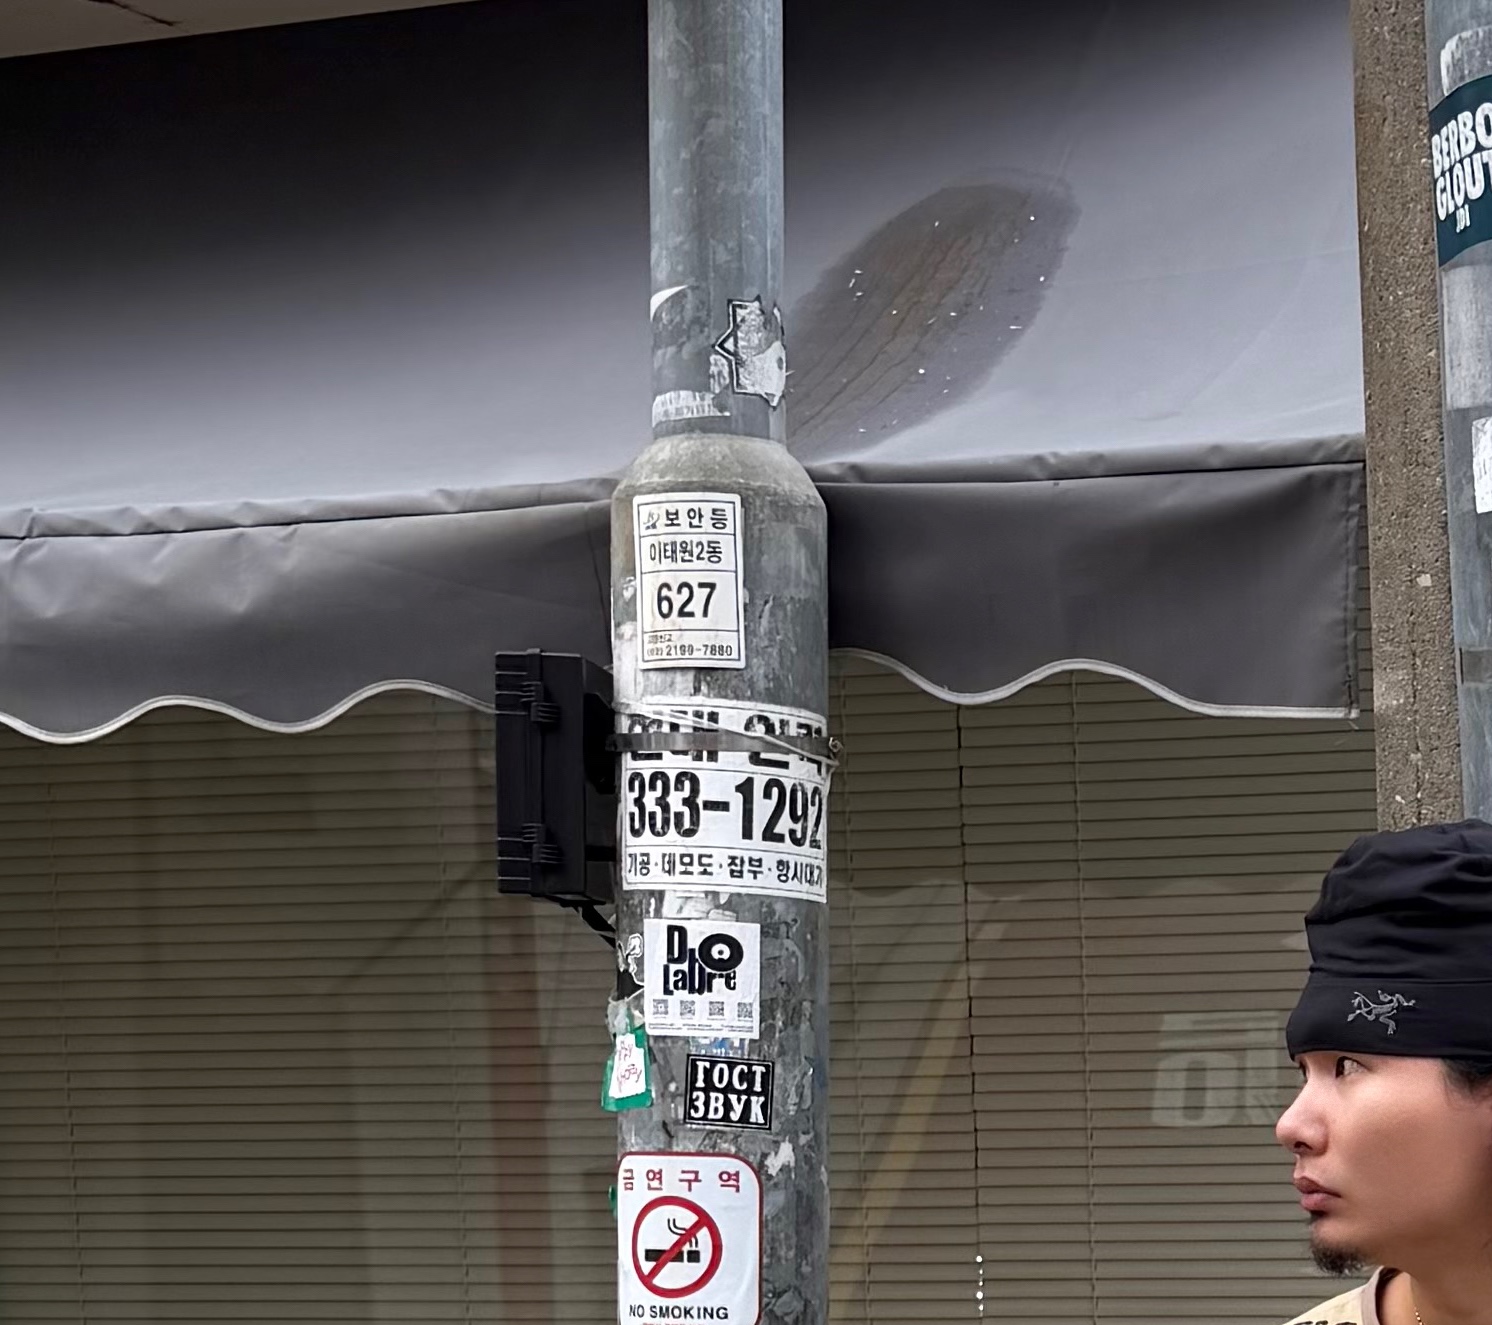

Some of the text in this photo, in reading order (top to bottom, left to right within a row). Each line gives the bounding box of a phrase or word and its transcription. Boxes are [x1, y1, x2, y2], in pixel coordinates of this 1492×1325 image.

[649, 540, 723, 564] 이태원2동
[657, 581, 717, 619] 627
[627, 770, 823, 850] 333-1292
[695, 1060, 767, 1092] ГОСТ
[689, 1091, 766, 1124] ЗВУК
[629, 1304, 729, 1320] NO SMOKING
